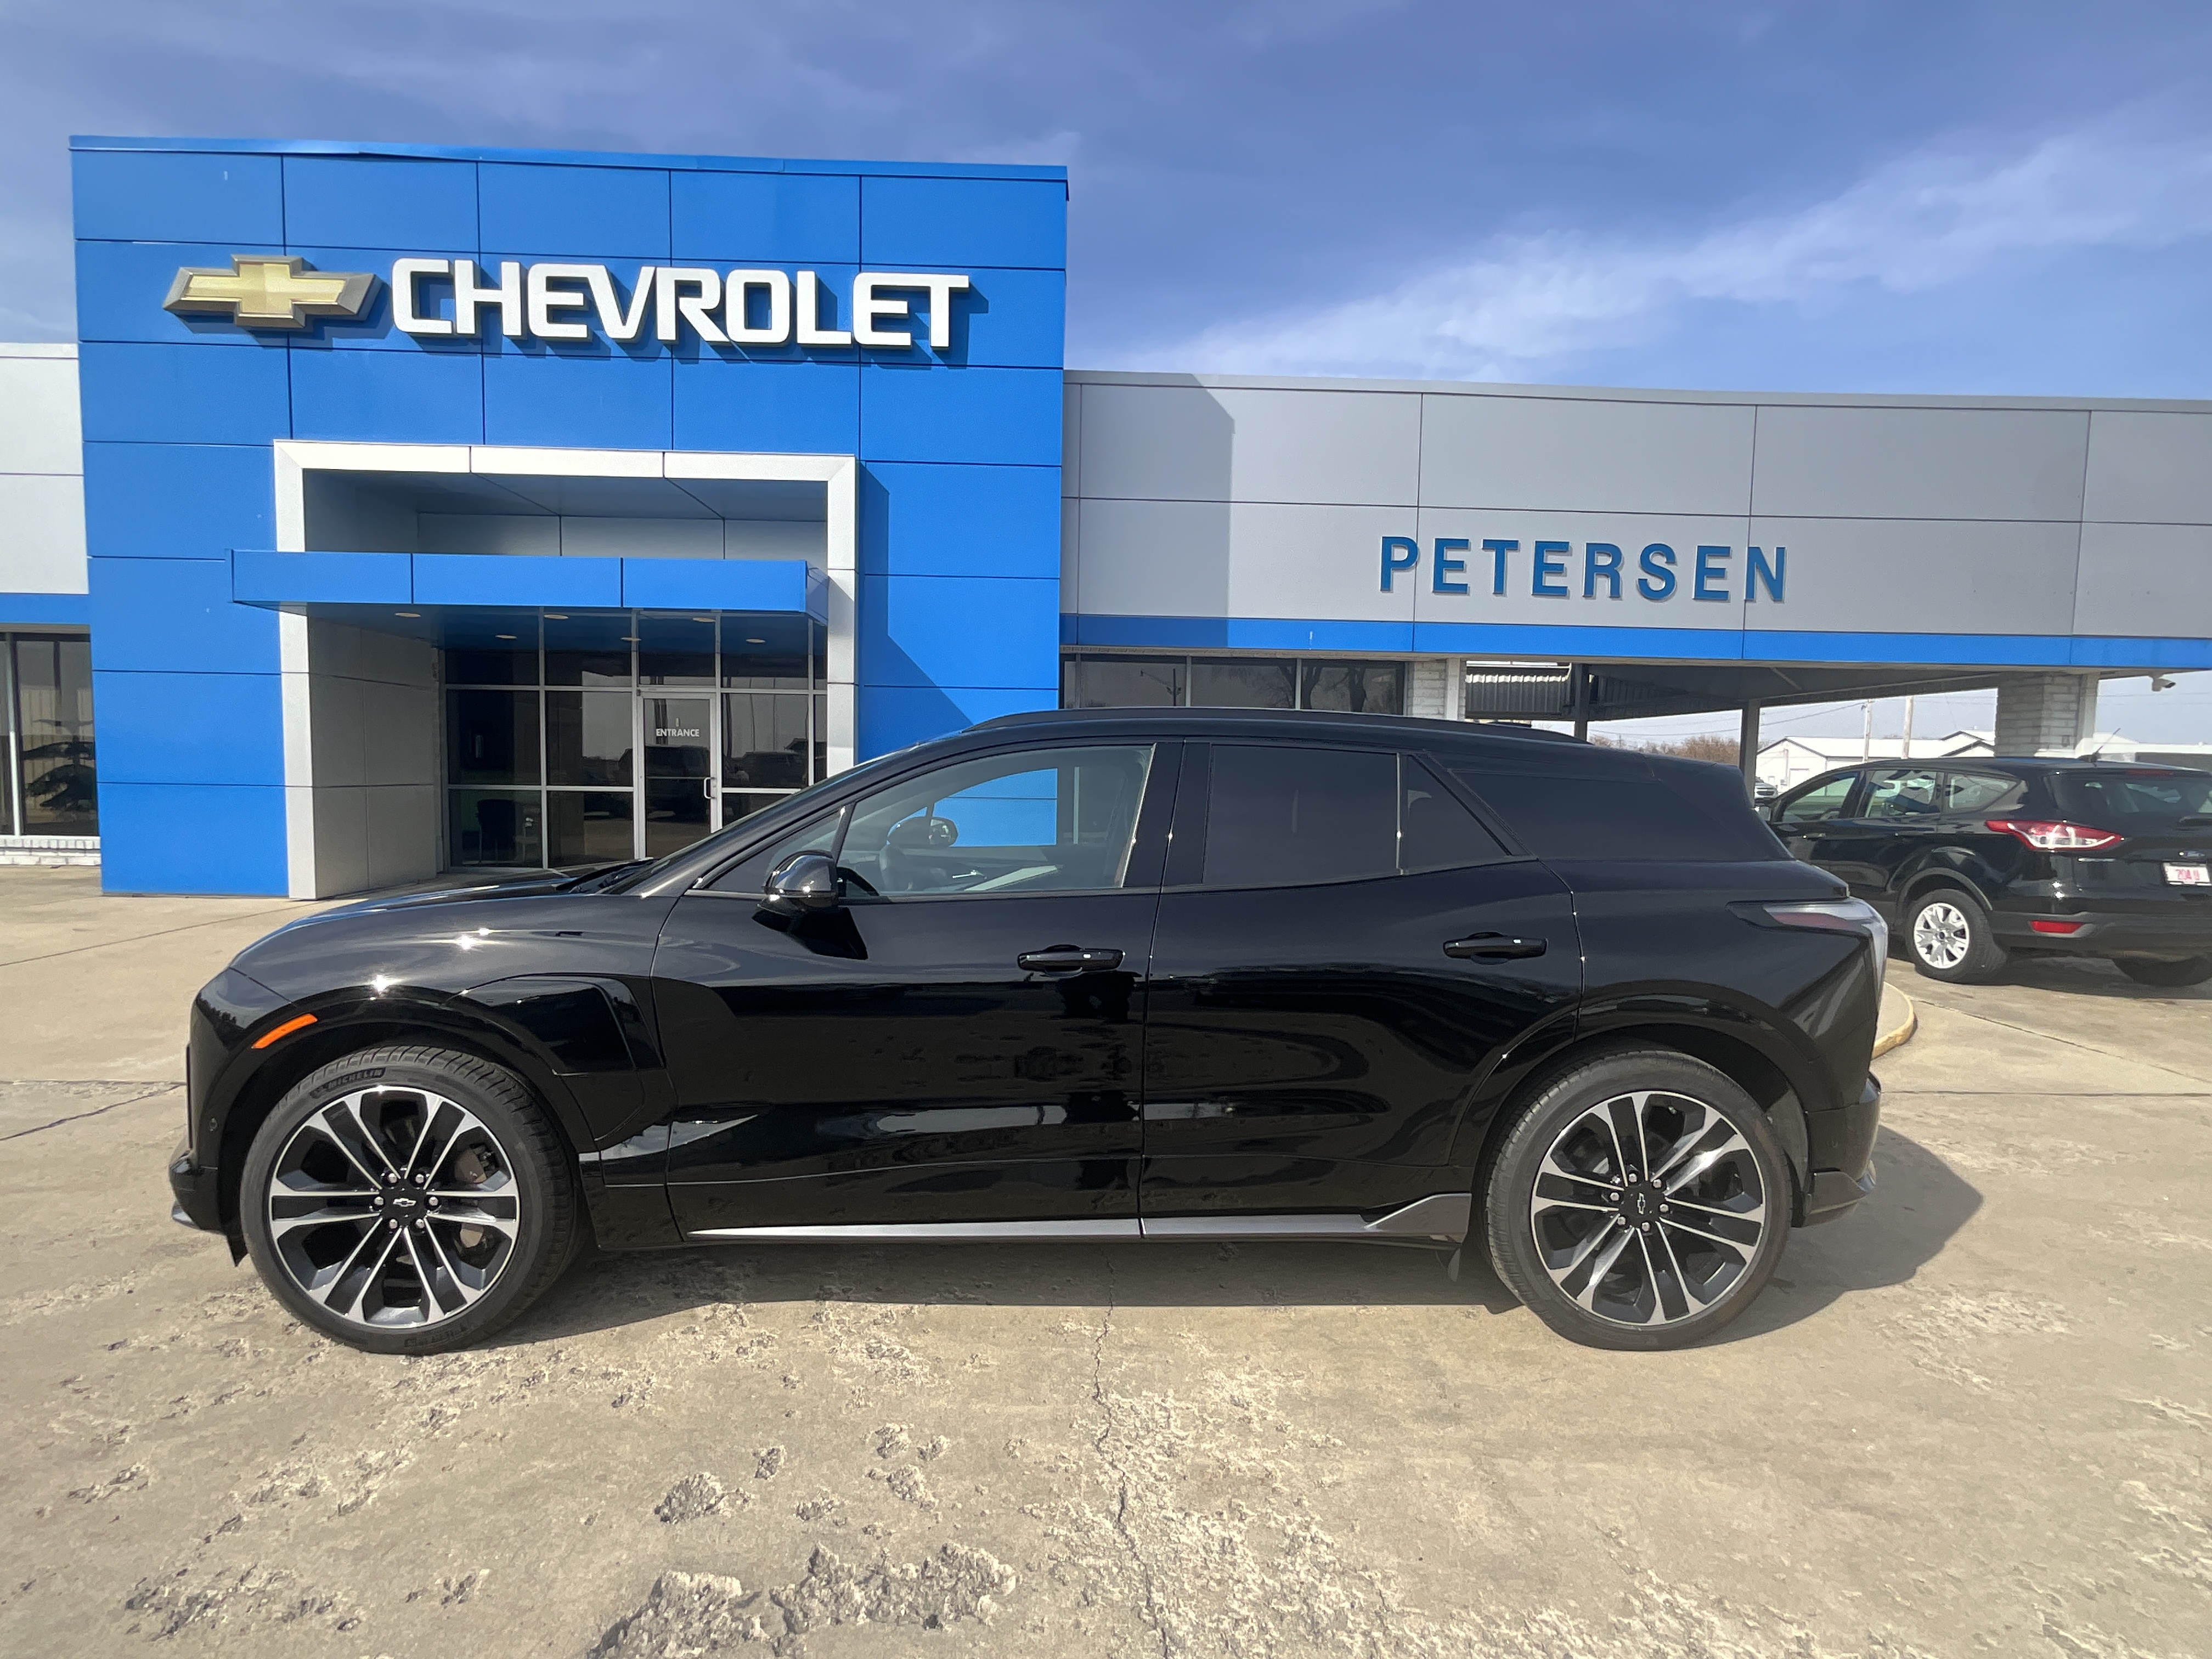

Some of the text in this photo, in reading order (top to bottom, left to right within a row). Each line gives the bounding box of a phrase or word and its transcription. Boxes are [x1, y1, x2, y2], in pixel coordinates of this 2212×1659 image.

[392, 258, 969, 348] CHEVROLET
[1380, 536, 1786, 602] PETERSEN
[656, 729, 699, 737] ENTRANCE
[328, 1069, 383, 1089] MICHELIN
